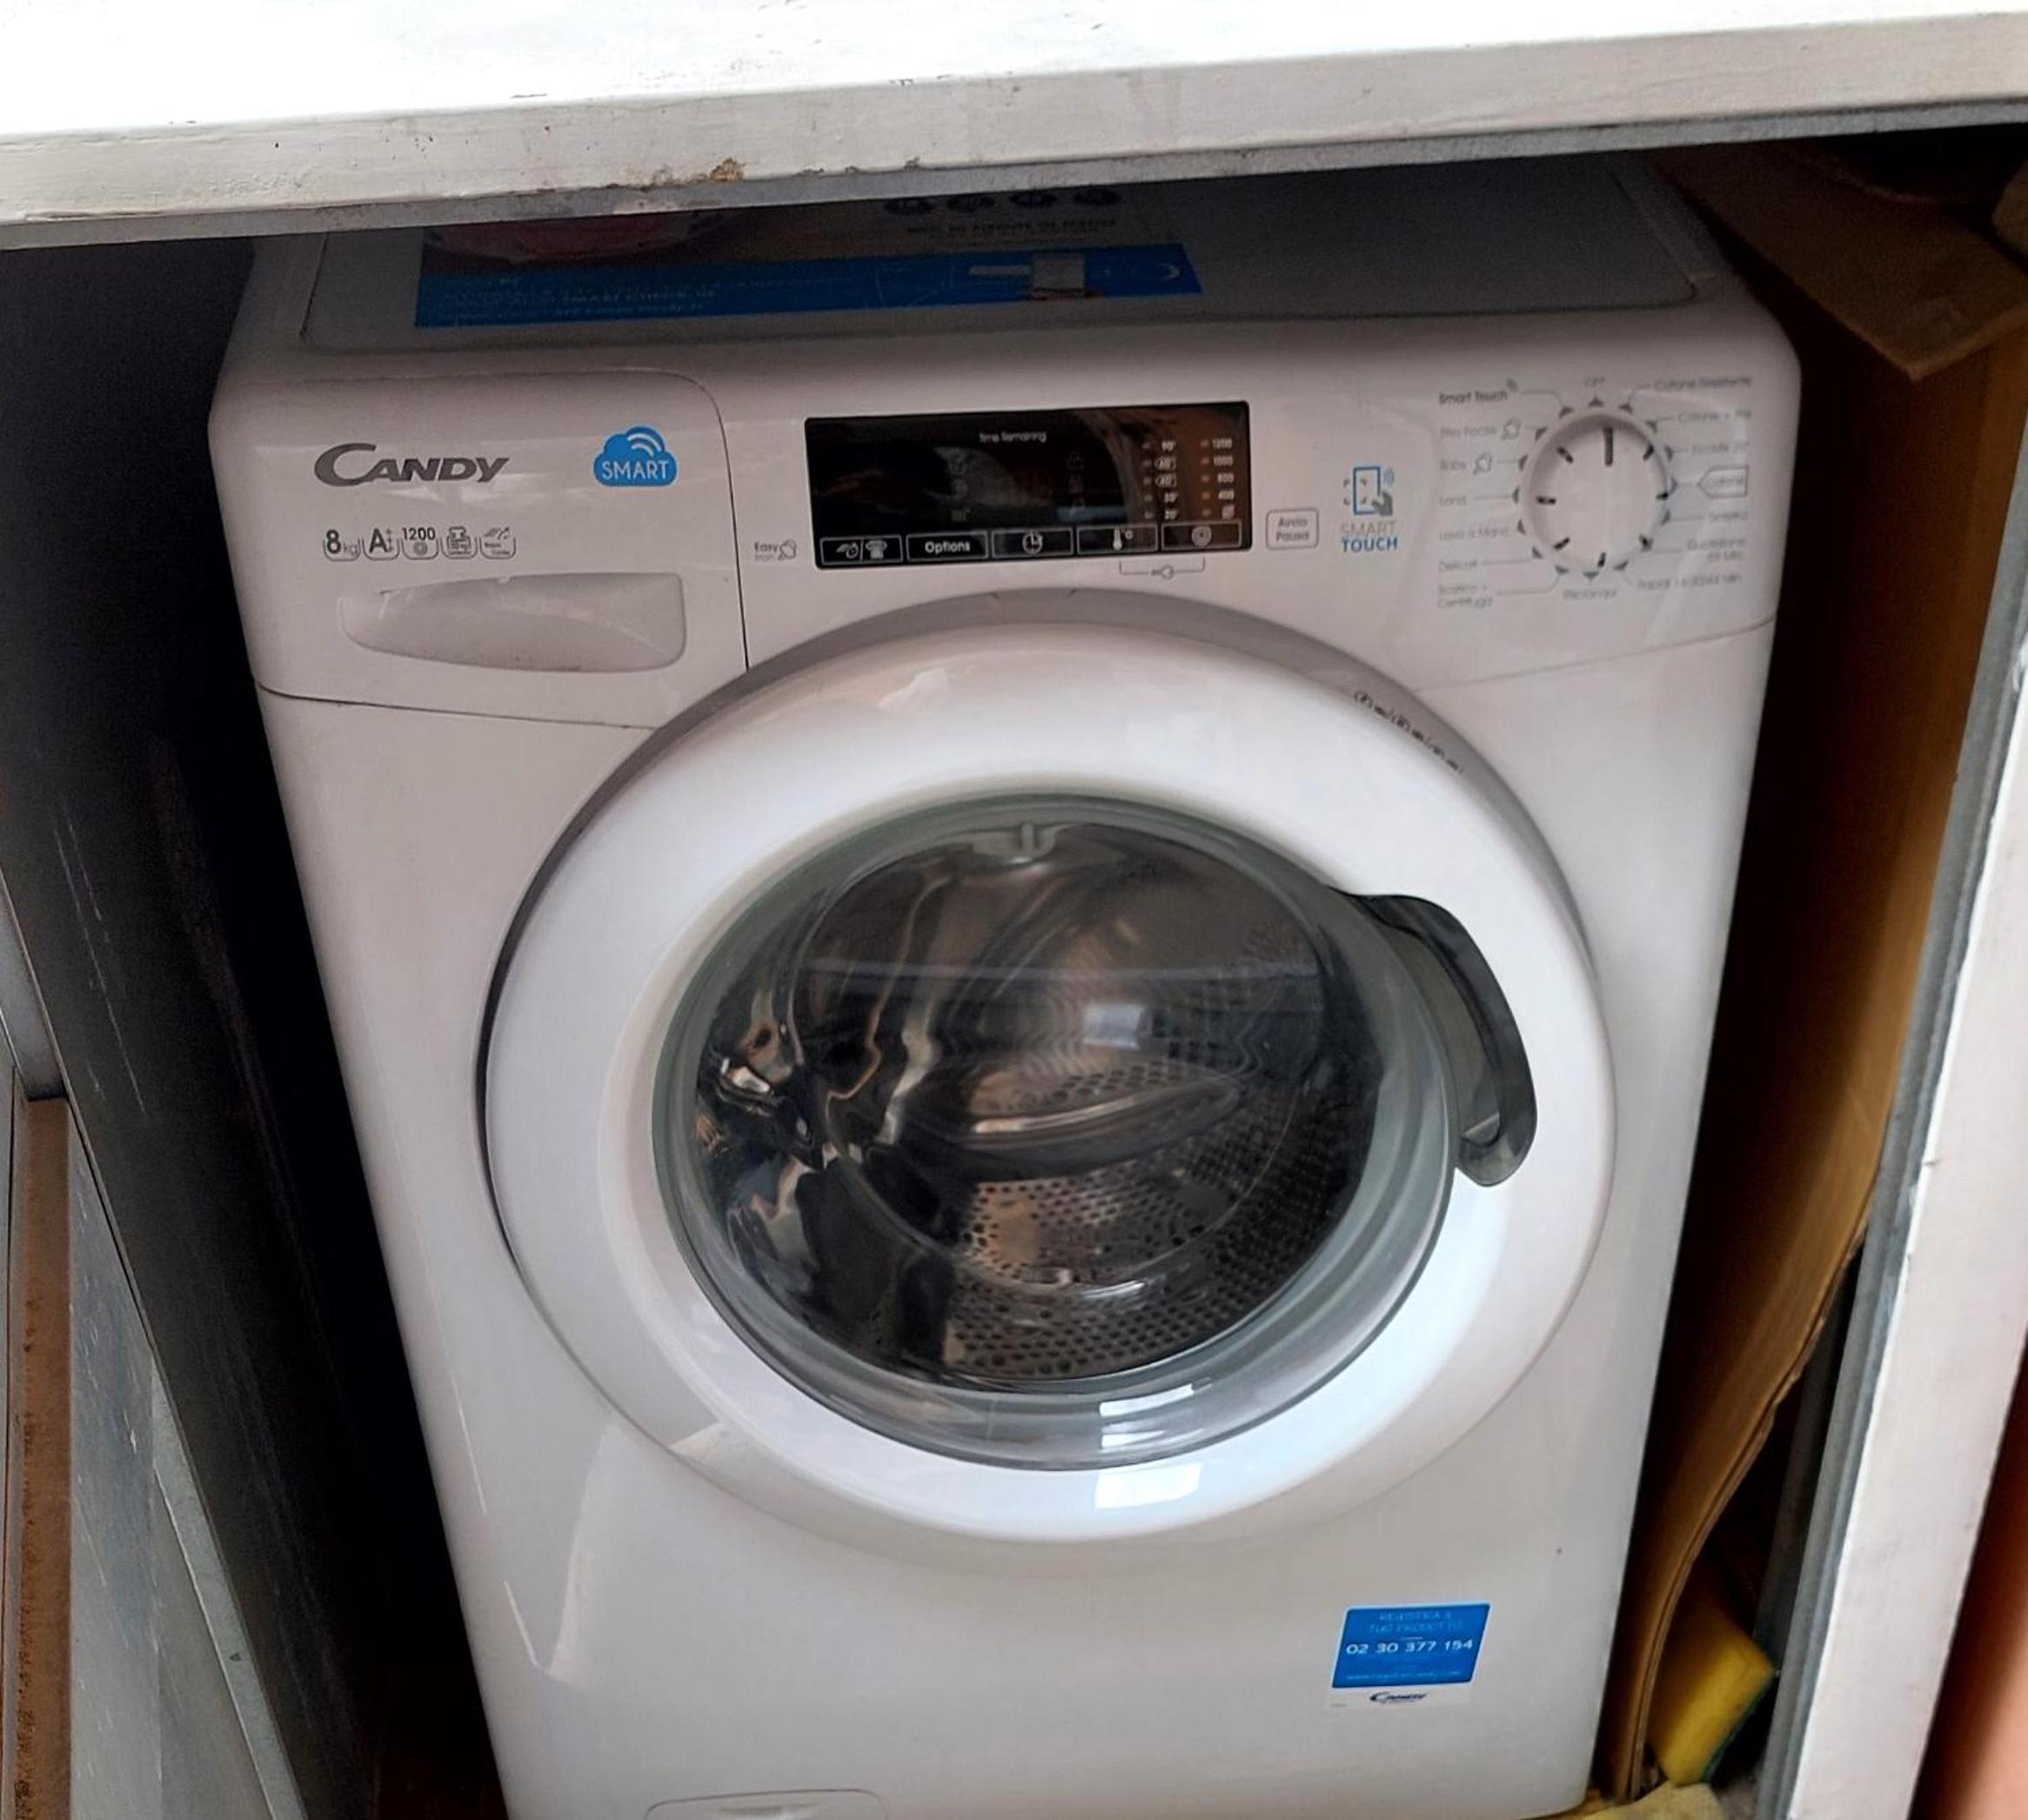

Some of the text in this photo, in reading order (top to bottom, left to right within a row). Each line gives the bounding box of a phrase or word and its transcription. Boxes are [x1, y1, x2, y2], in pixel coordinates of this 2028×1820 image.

[1438, 390, 1509, 405] Smart Touch
[314, 442, 510, 487] CANDY
[601, 459, 670, 480] SMART
[402, 526, 436, 541] 1200
[1341, 521, 1395, 536] SMART
[924, 539, 971, 555] Options
[1341, 537, 1398, 553] TOUCH
[1346, 1638, 1474, 1655] 02 30 377 154
